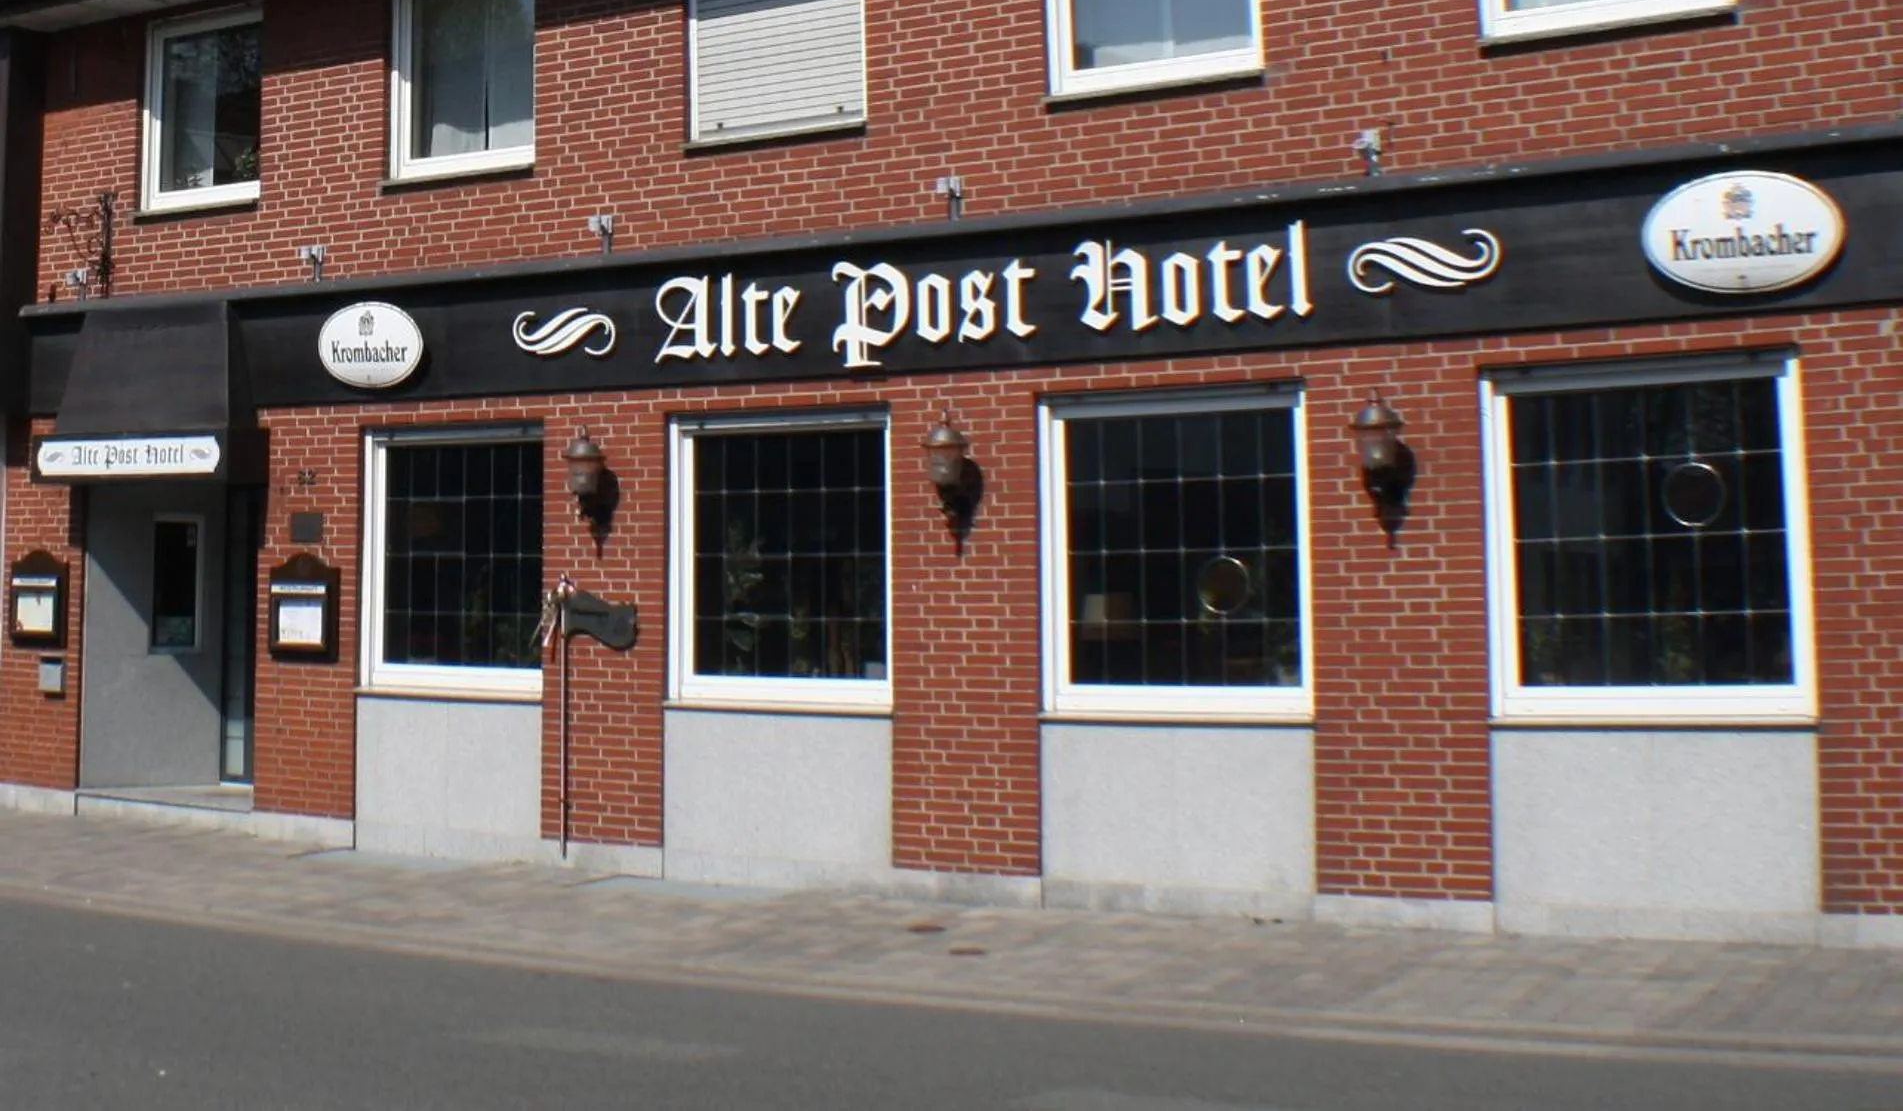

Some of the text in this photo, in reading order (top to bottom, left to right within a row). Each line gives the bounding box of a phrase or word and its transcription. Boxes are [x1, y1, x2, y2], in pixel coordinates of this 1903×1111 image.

[1669, 223, 1817, 261] Krombacher
[655, 219, 1314, 367] Alte Post Hotel
[331, 339, 408, 363] Krombacher
[71, 444, 184, 470] Alte Post Hotel
